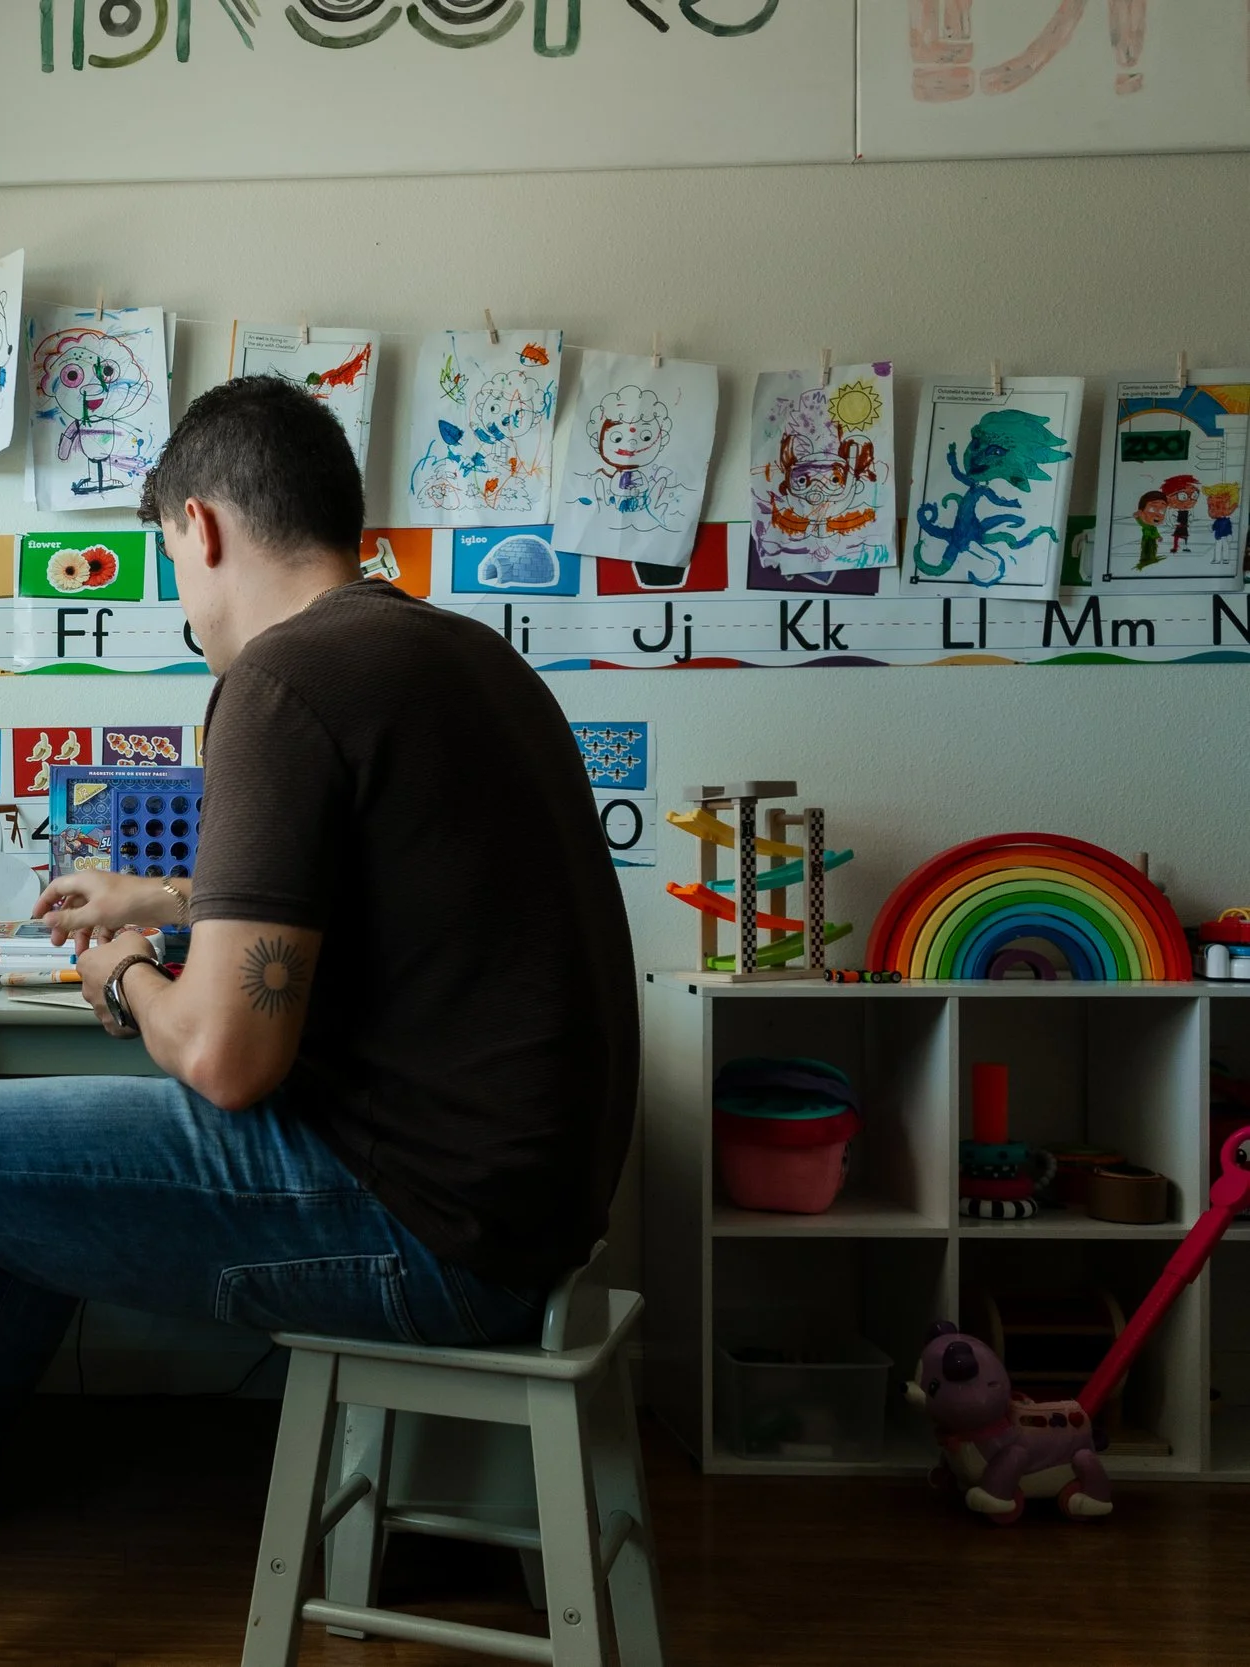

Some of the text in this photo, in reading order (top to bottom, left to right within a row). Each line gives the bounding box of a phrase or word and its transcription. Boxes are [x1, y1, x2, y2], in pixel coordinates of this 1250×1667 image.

[1124, 436, 1185, 456] ZOO
[27, 540, 62, 549] flower
[460, 535, 488, 545] igloo
[56, 608, 113, 658] Ff
[632, 602, 693, 663] Jj
[780, 600, 849, 652] Kk
[943, 598, 987, 649] Ll
[1043, 595, 1155, 648] Mm
